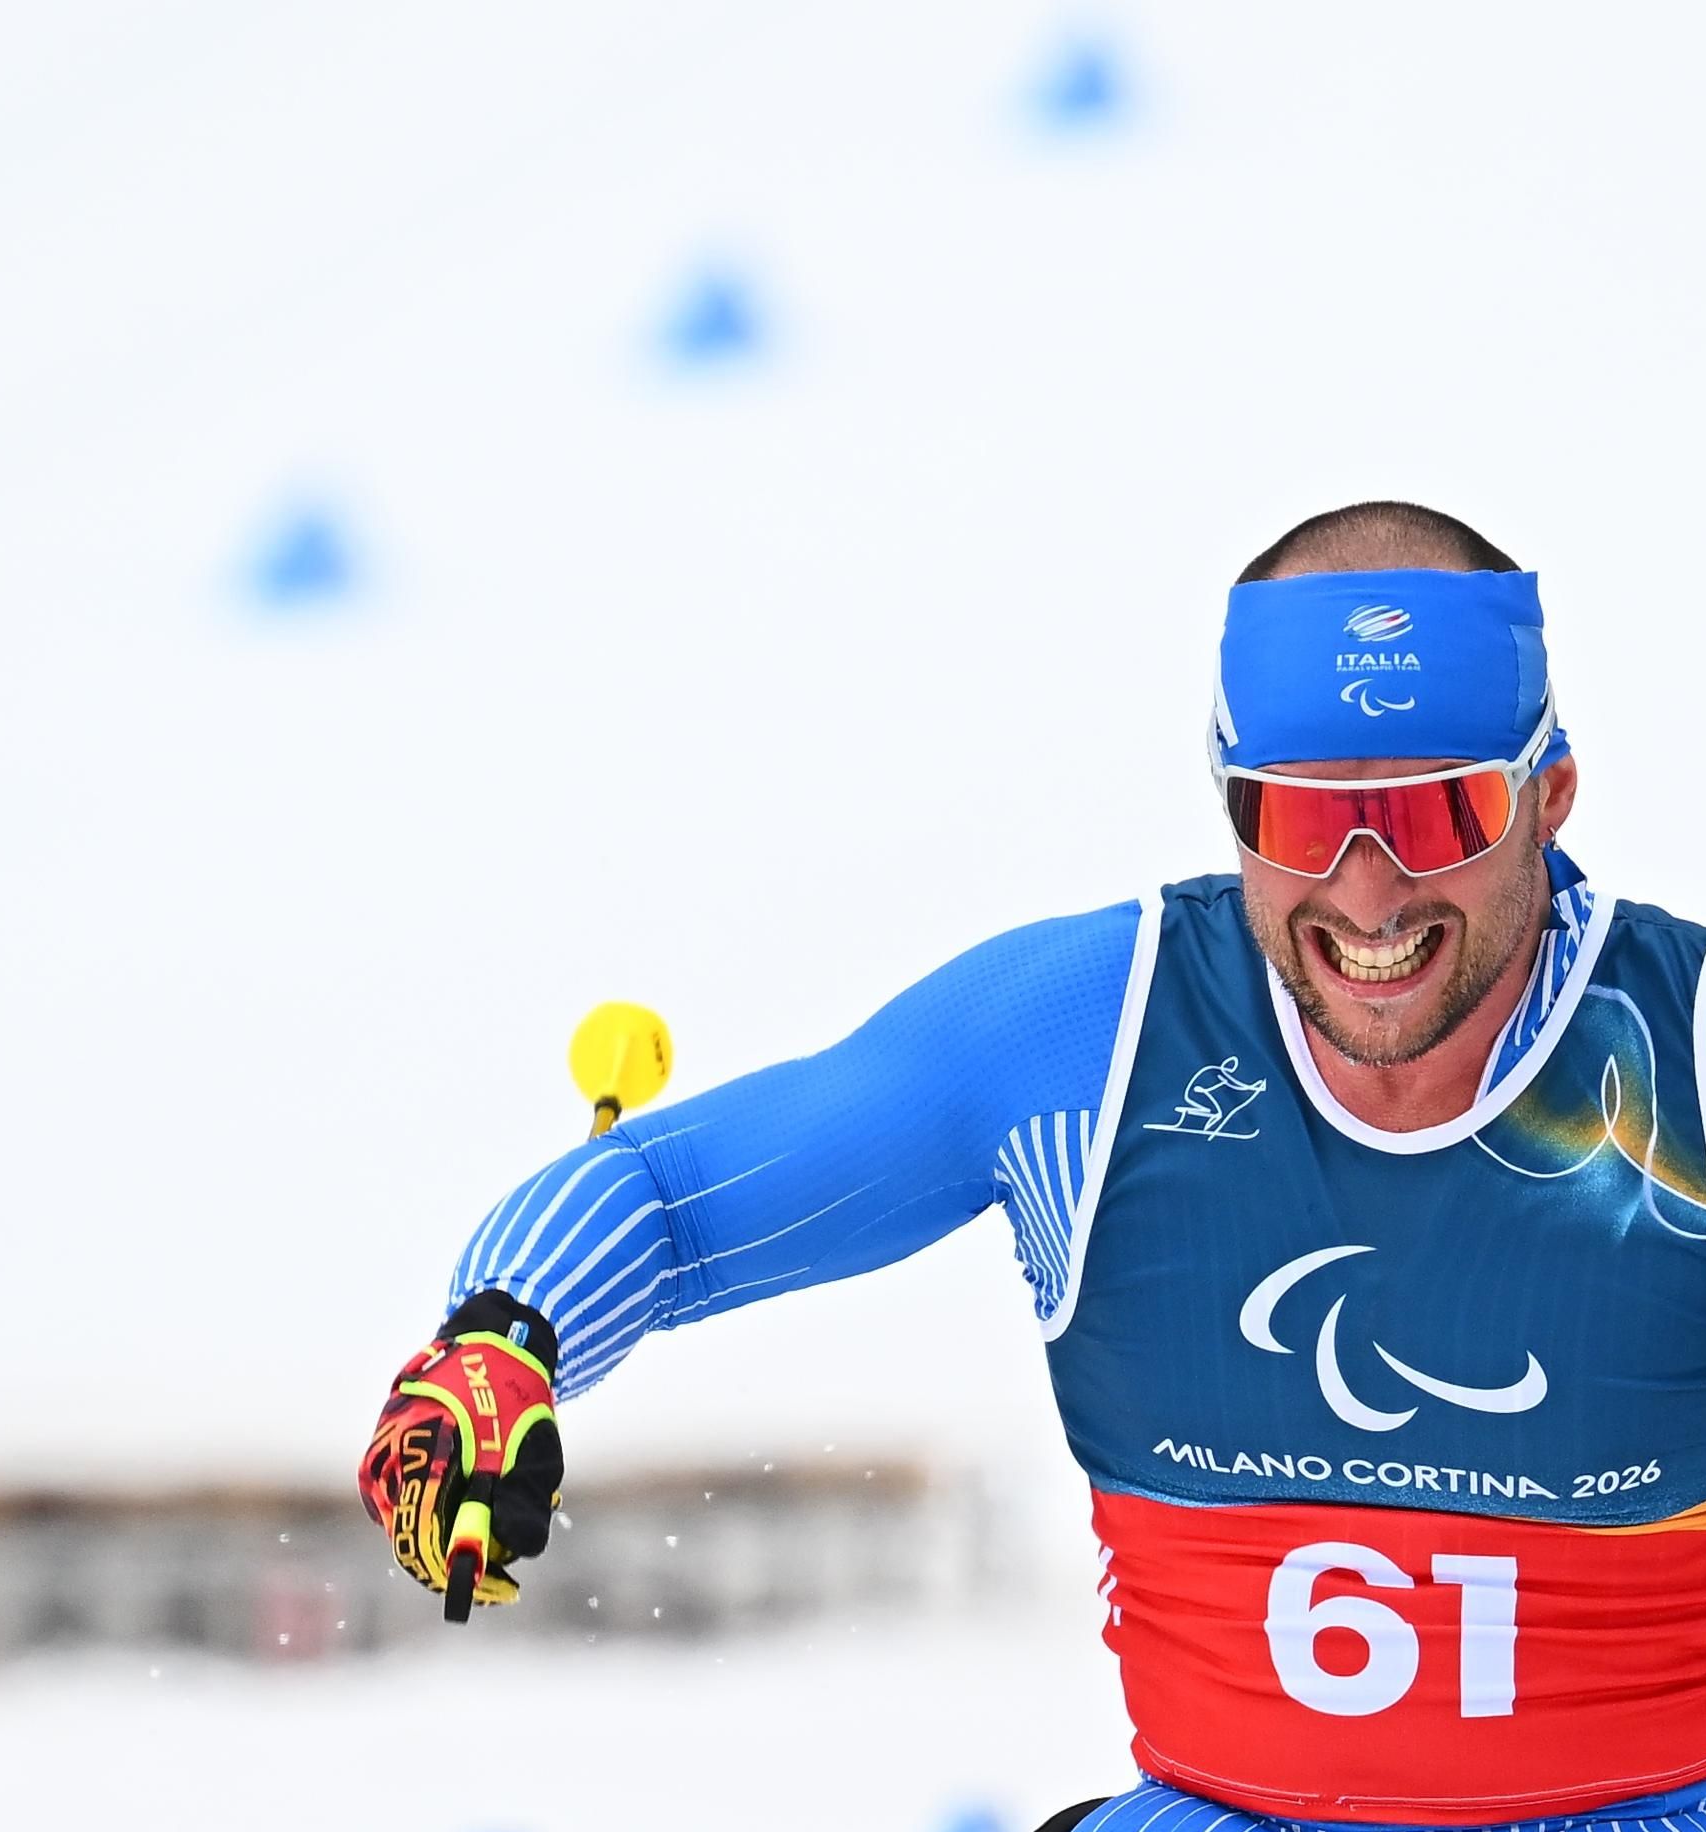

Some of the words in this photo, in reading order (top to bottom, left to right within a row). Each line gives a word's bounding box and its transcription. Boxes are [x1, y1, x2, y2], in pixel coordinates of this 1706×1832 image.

[1336, 653, 1420, 666] ITALIA
[461, 1353, 501, 1452] LEKI
[1152, 1438, 1333, 1481] MILANO
[1342, 1458, 1560, 1500] CORTINA
[1571, 1458, 1662, 1499] 2026
[1263, 1541, 1518, 1718] 61
